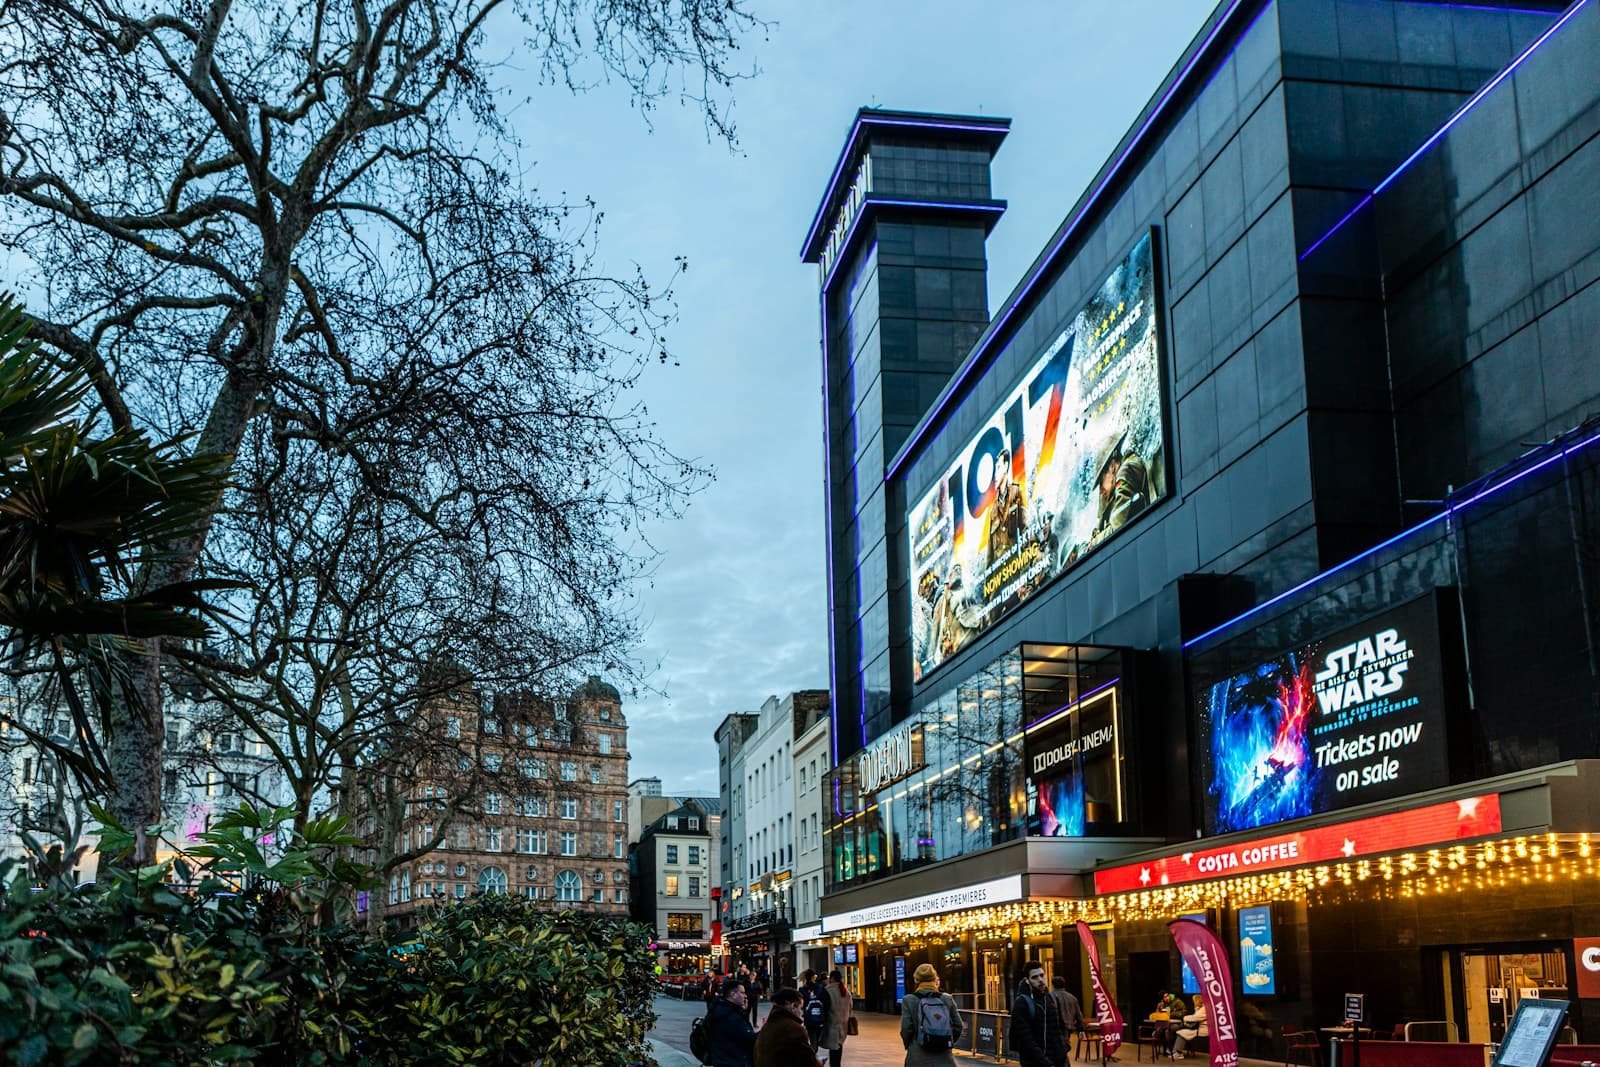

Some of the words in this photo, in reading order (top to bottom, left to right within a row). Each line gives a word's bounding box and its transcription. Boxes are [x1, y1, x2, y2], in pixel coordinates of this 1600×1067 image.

[948, 331, 1076, 562] 1917
[983, 571, 1003, 597] NOW
[1002, 542, 1040, 582] SHOWING
[1312, 683, 1326, 693] THE
[1328, 674, 1346, 688] RISE
[1349, 669, 1360, 680] OF
[1362, 649, 1414, 675] SKYWALKER
[1315, 627, 1407, 684] STAR
[1316, 661, 1408, 716] WARS
[1338, 711, 1347, 721] IN
[1350, 697, 1390, 717] CINEMAS
[1313, 716, 1354, 736] THURSDAY
[1358, 711, 1367, 723] 19
[1371, 696, 1420, 719] DECEMBER
[859, 725, 913, 796] ODEON
[1046, 739, 1077, 767] DOLBY
[1315, 733, 1376, 768] Tickets
[1378, 722, 1423, 752] now
[1336, 769, 1359, 793] on
[1361, 755, 1400, 786] sale
[1197, 852, 1239, 873] COSTA
[1241, 841, 1299, 865] COFFEE
[876, 906, 900, 919] LEICESTER
[900, 902, 921, 916] SQUARE
[922, 898, 939, 911] HOME
[940, 897, 948, 908] OF
[950, 888, 987, 906] PREMIERES
[1096, 992, 1113, 1025] Now
